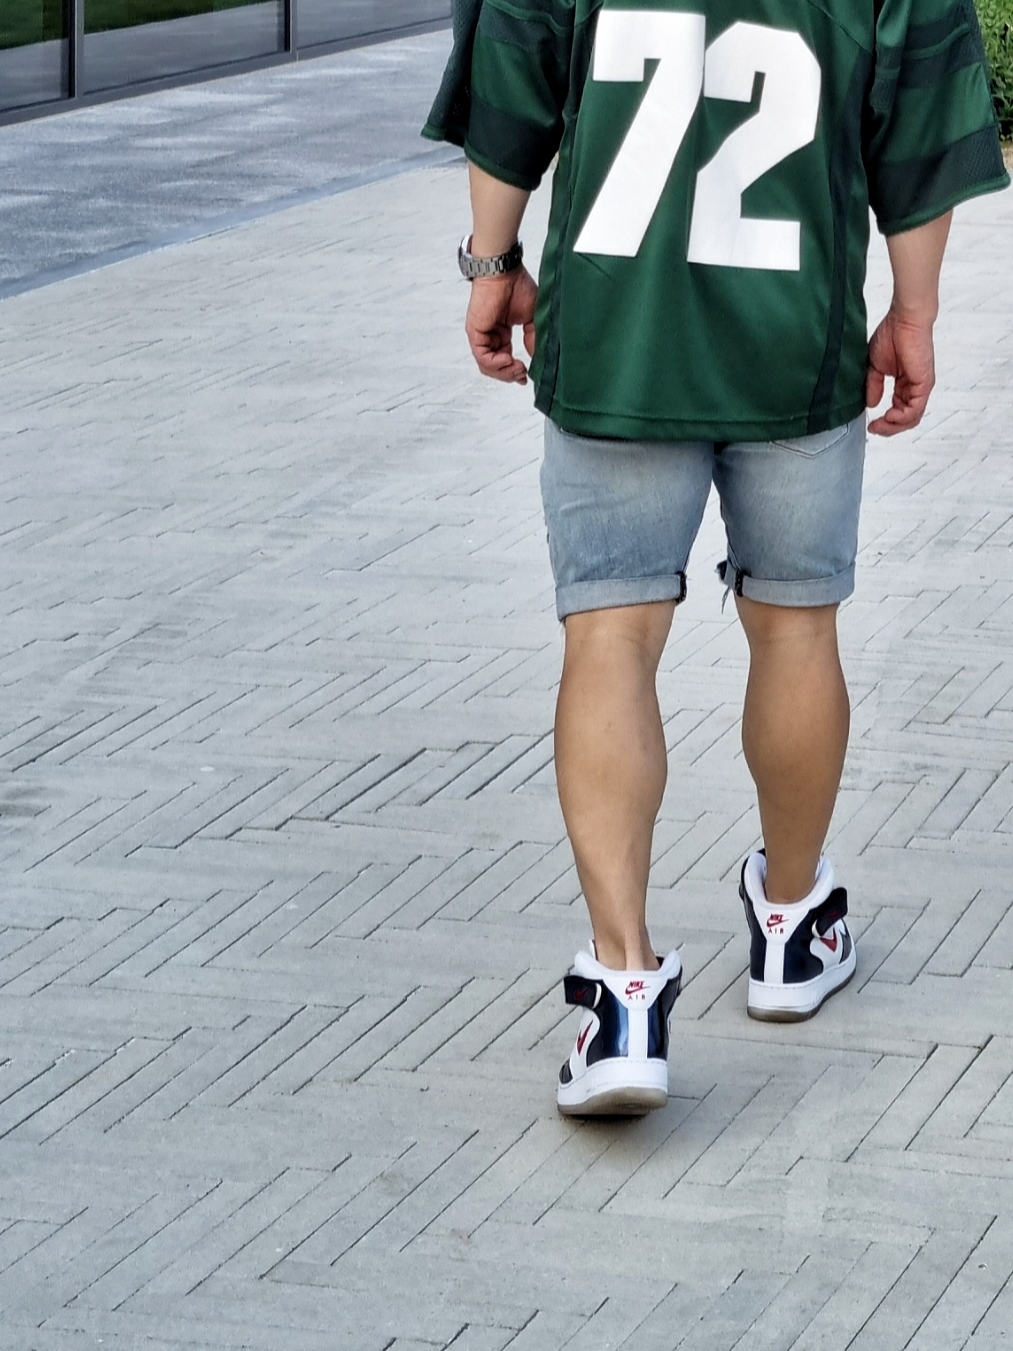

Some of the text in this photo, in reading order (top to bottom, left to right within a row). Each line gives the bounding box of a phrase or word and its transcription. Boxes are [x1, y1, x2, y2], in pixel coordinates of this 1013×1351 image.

[573, 10, 821, 271] 72
[769, 913, 784, 922] NIKE
[627, 980, 645, 989] NIKE
